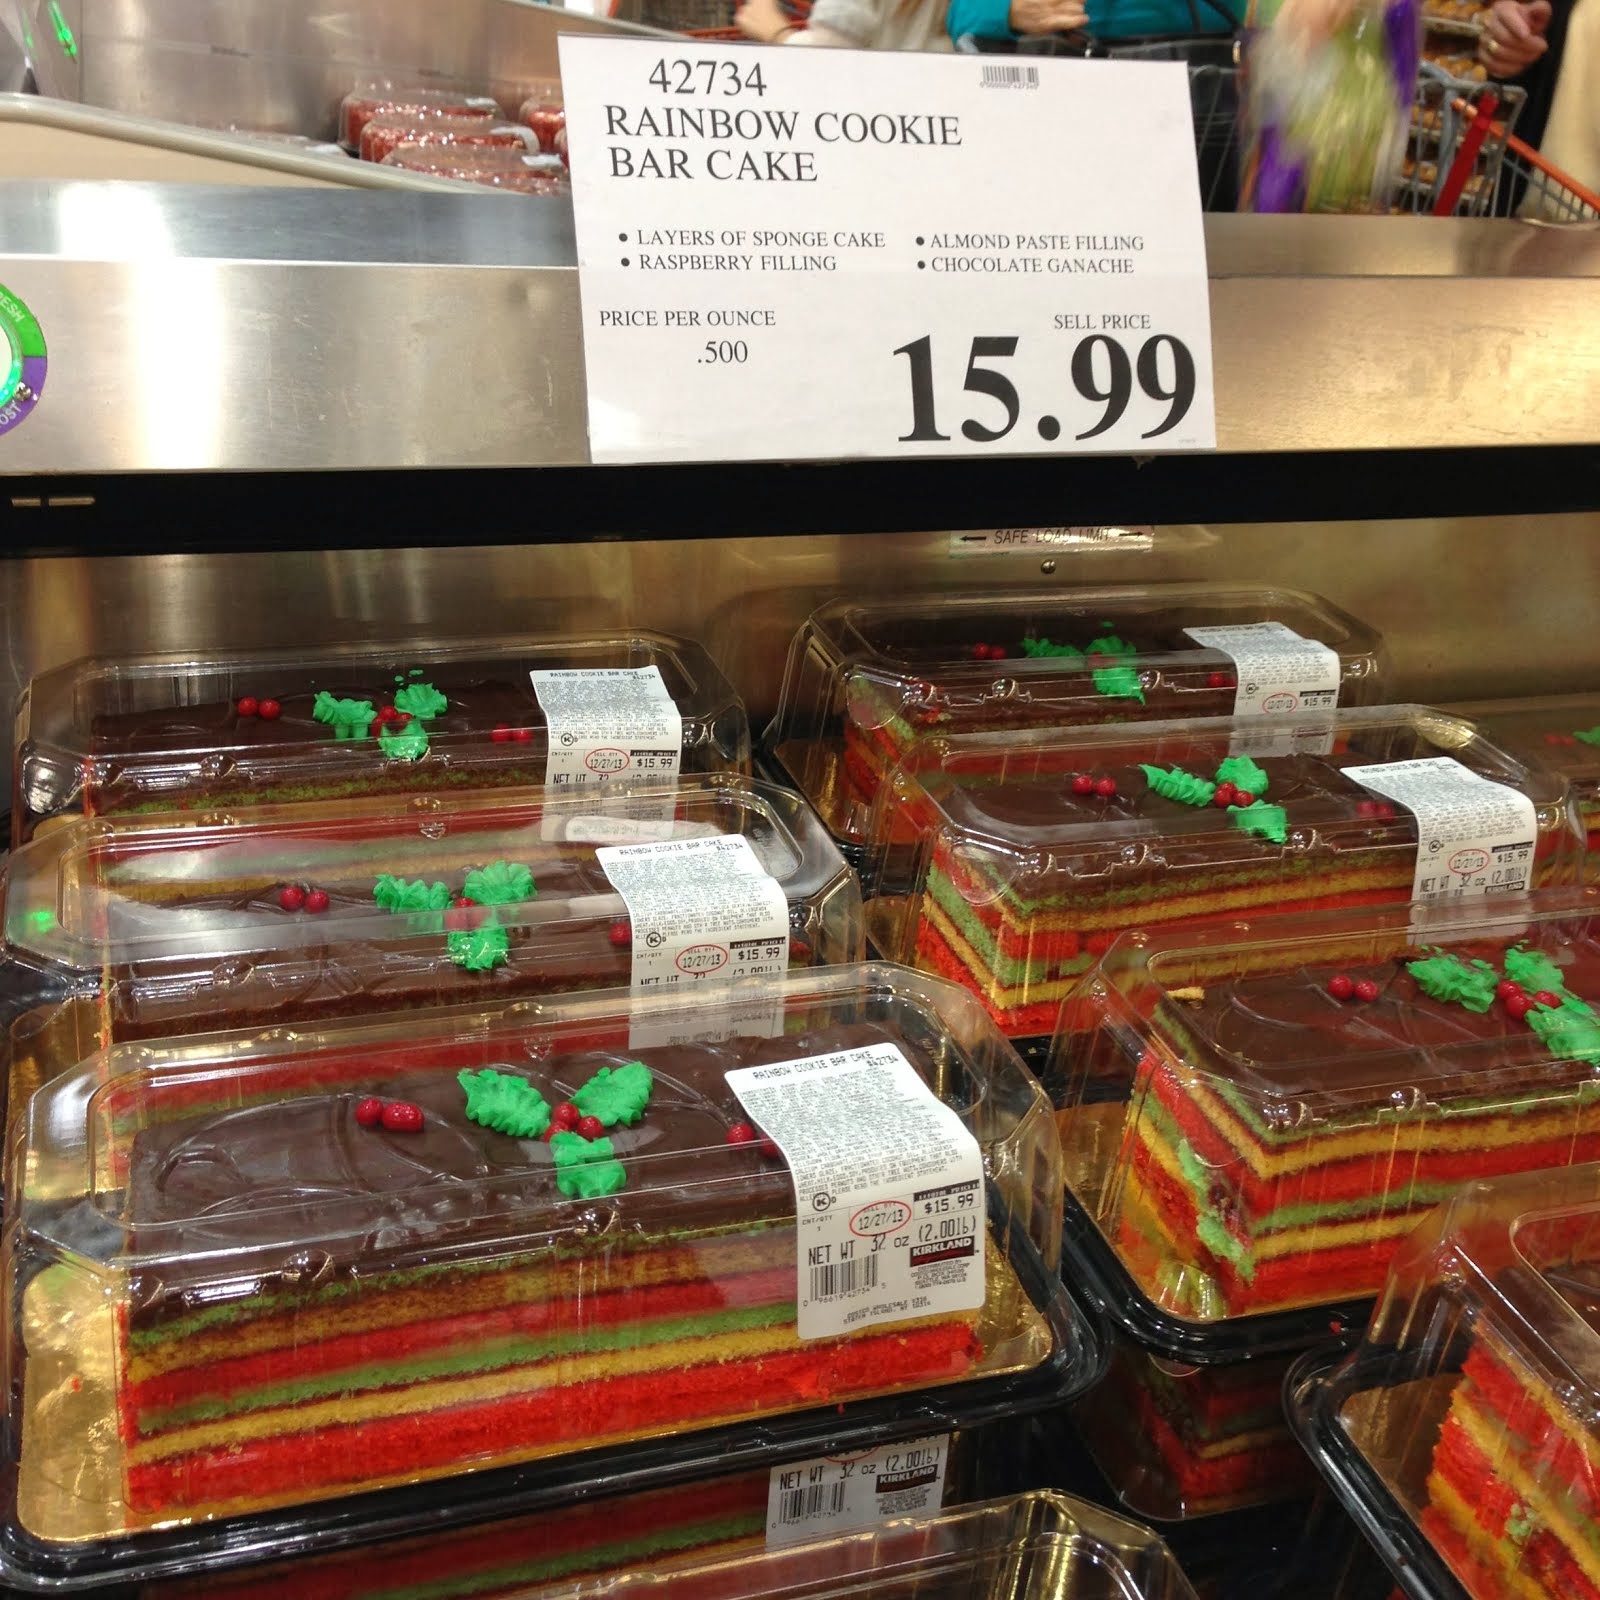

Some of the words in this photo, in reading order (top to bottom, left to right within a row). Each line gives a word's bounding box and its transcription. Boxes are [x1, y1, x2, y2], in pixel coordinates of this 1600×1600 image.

[648, 58, 767, 97] 42734
[605, 105, 799, 141] RAINBOW
[814, 112, 962, 146] COOKIE
[609, 146, 693, 179] BAR
[706, 149, 818, 182] CAKE
[637, 229, 715, 246] LAYERS
[720, 230, 746, 246] OF
[752, 230, 829, 247] SPONGE
[833, 231, 886, 248] CAKE
[930, 233, 1011, 250] ALMOND
[1016, 234, 1071, 250] PASTE
[1075, 235, 1144, 251] FILLING
[639, 254, 754, 271] RASPBERRY
[761, 255, 837, 271] FILLING
[931, 256, 1043, 273] CHOCOLATE
[1047, 258, 1135, 274] GANACHE
[599, 310, 659, 327] PRICE
[664, 310, 702, 327] PER
[706, 310, 777, 327] OUNCE
[1054, 314, 1097, 330] SELL
[1101, 314, 1152, 330] PRICE
[697, 340, 748, 364] .500
[892, 333, 1196, 443] 15.99
[994, 530, 1028, 544] SAFE
[1036, 528, 1072, 543] LOAD
[1079, 527, 1111, 541] LIMIT
[590, 758, 622, 769] 12/27/13
[637, 758, 673, 769] $15.99
[619, 847, 652, 856] RAINBOW
[656, 844, 682, 853] COOKIE
[687, 841, 700, 850] BAR
[704, 839, 723, 848] CAKE
[1497, 850, 1529, 863] $15.99
[1453, 856, 1485, 870] 12/27/13
[1420, 877, 1437, 892] NET
[1440, 875, 1450, 889] WT
[1459, 872, 1472, 887] 32
[682, 954, 721, 969] 12/27/13
[738, 947, 780, 961] $15.99
[753, 1064, 792, 1081] RAINBOW
[797, 1059, 827, 1074] COOKIE
[832, 1055, 847, 1067] BAR
[851, 1050, 873, 1063] CAKE
[866, 1054, 899, 1068] #42734
[924, 1192, 975, 1214] $15.99
[802, 1214, 833, 1226] CNT/QTY
[858, 1209, 904, 1230] 12/27/13
[808, 1244, 832, 1266] NET
[841, 1240, 856, 1259] WT
[871, 1233, 886, 1253] 32
[918, 1216, 977, 1243] (2.00lb)
[912, 1237, 973, 1257] KIRKLAND
[780, 1470, 802, 1490] NET
[809, 1466, 824, 1483] WT
[840, 1461, 855, 1479] 32
[885, 1446, 940, 1473] (2.00lb)
[879, 1465, 935, 1484] KIRKLAND
